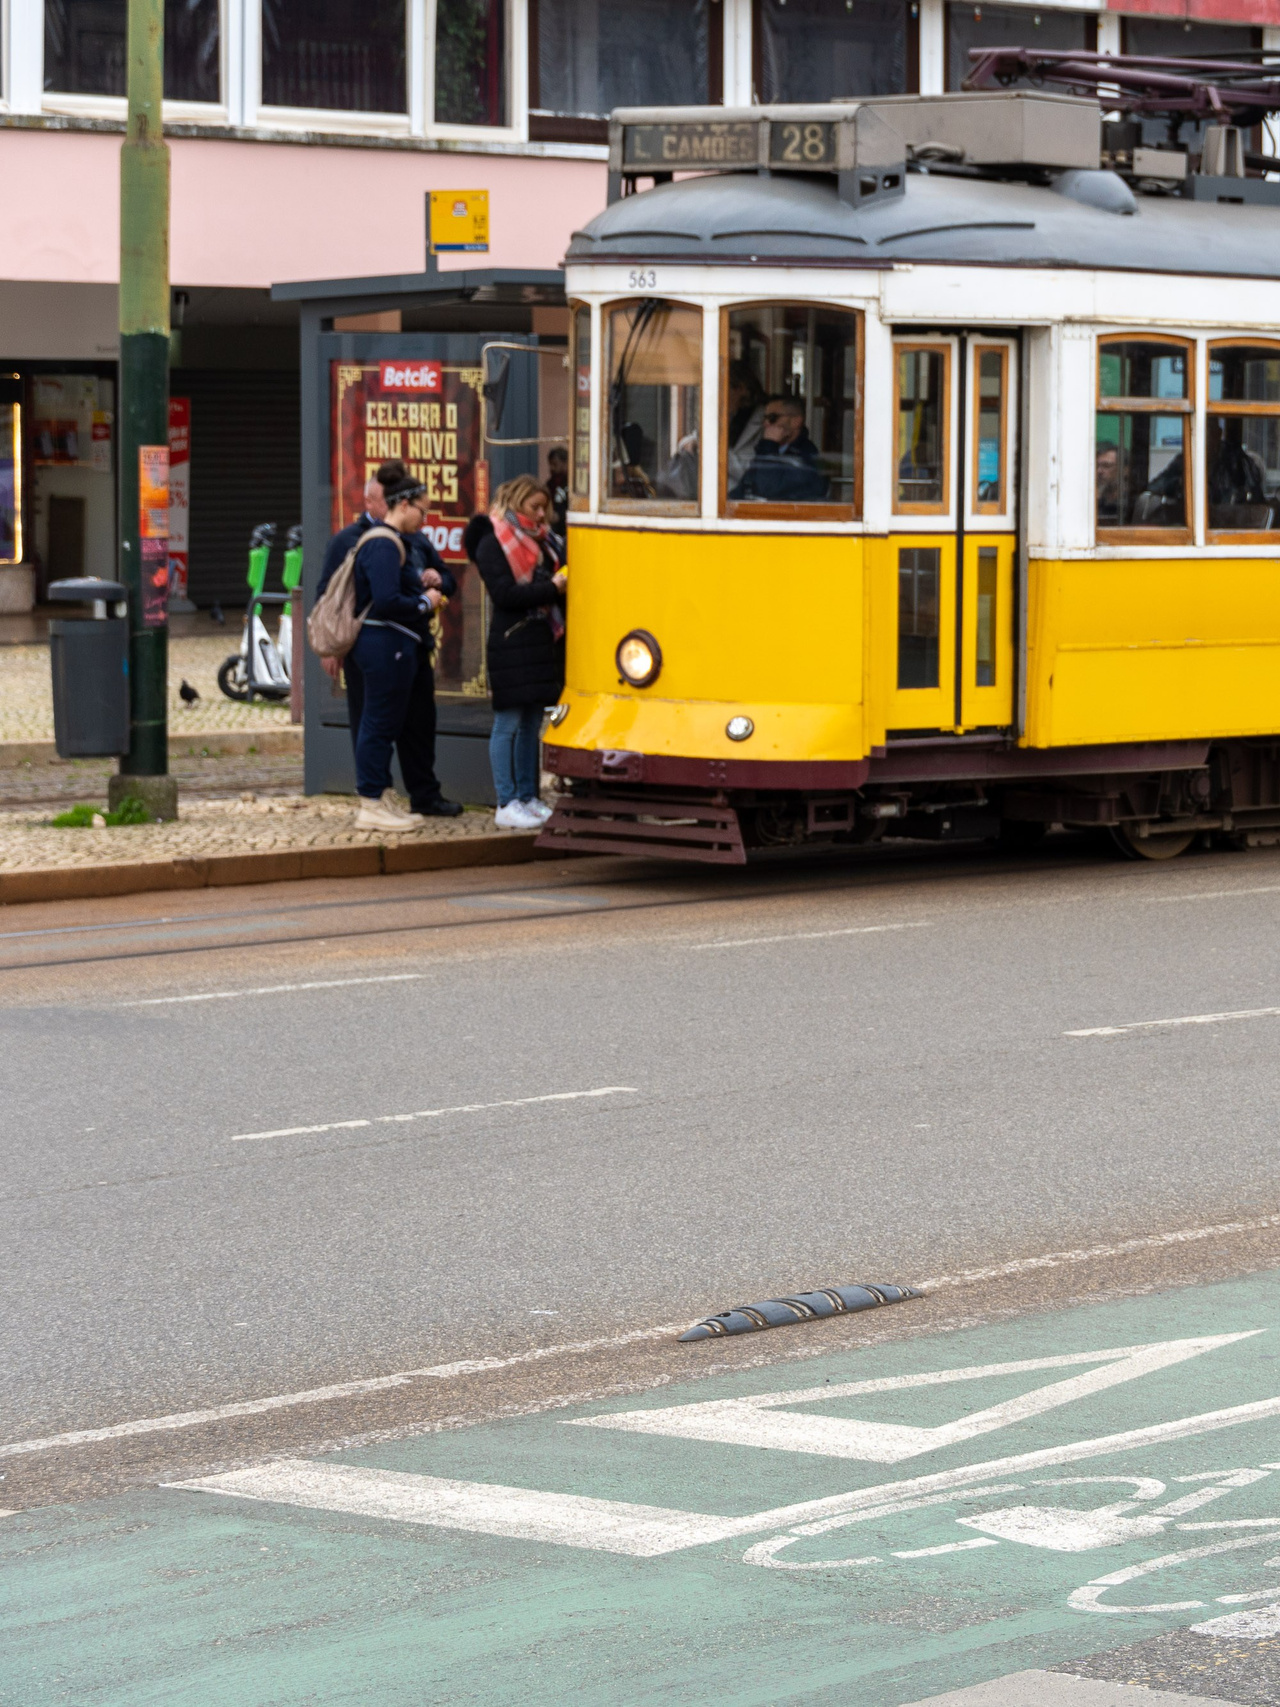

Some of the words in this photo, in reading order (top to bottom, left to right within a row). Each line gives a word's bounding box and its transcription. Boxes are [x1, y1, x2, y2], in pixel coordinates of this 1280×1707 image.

[782, 124, 825, 161] 28
[628, 270, 657, 289] 563
[383, 365, 438, 388] Betclic
[365, 402, 441, 430] CELEBRA
[446, 402, 458, 429] O
[365, 431, 402, 458] ANO
[408, 431, 458, 461] NOVO
